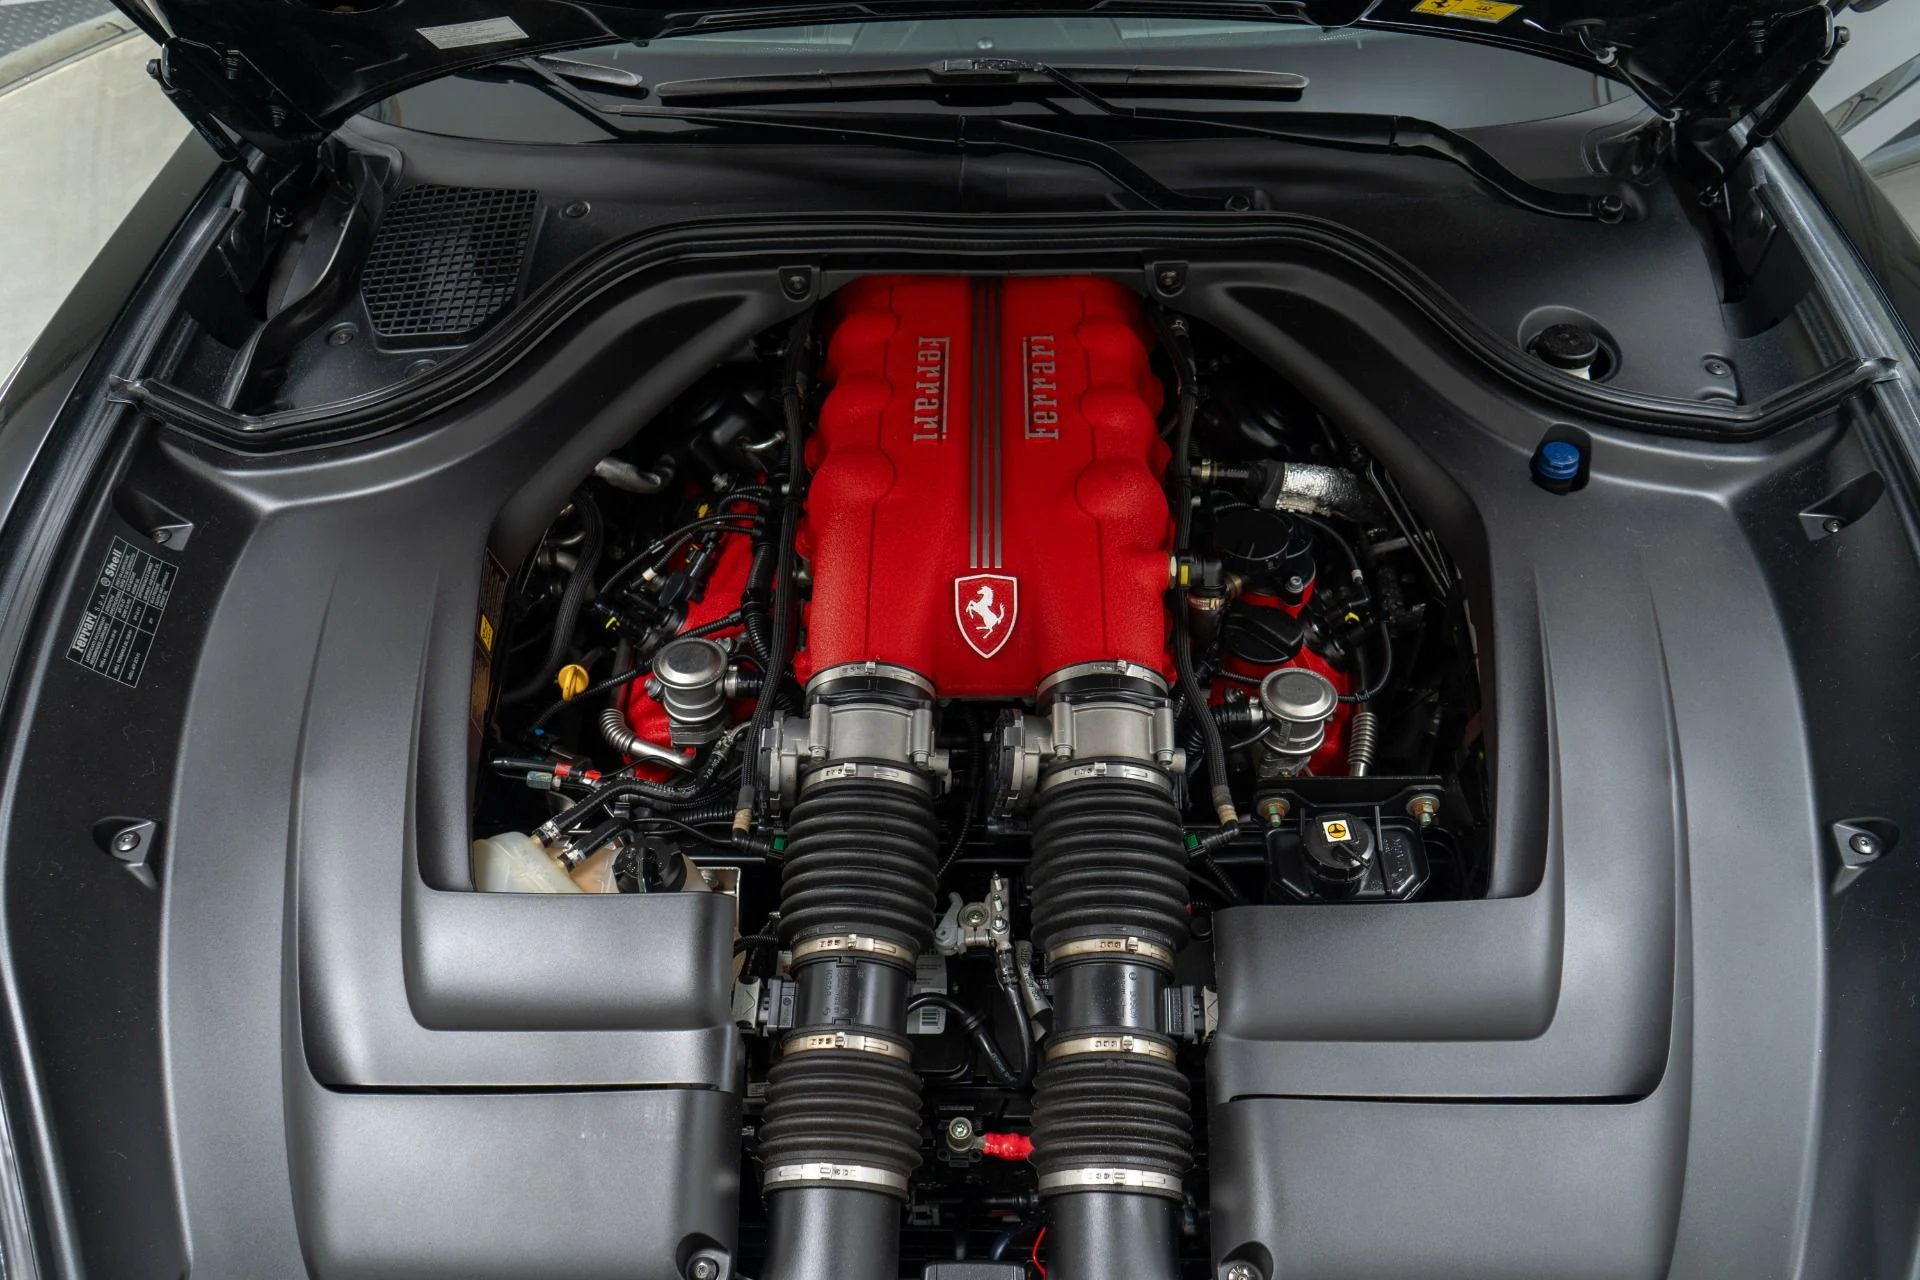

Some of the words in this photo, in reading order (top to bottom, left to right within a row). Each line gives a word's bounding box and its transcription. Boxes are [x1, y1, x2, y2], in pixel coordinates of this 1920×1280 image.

[912, 336, 950, 442] Ferrari
[1022, 334, 1059, 440] Ferrari
[72, 611, 98, 653] Ferrari
[105, 548, 122, 578] Shell
